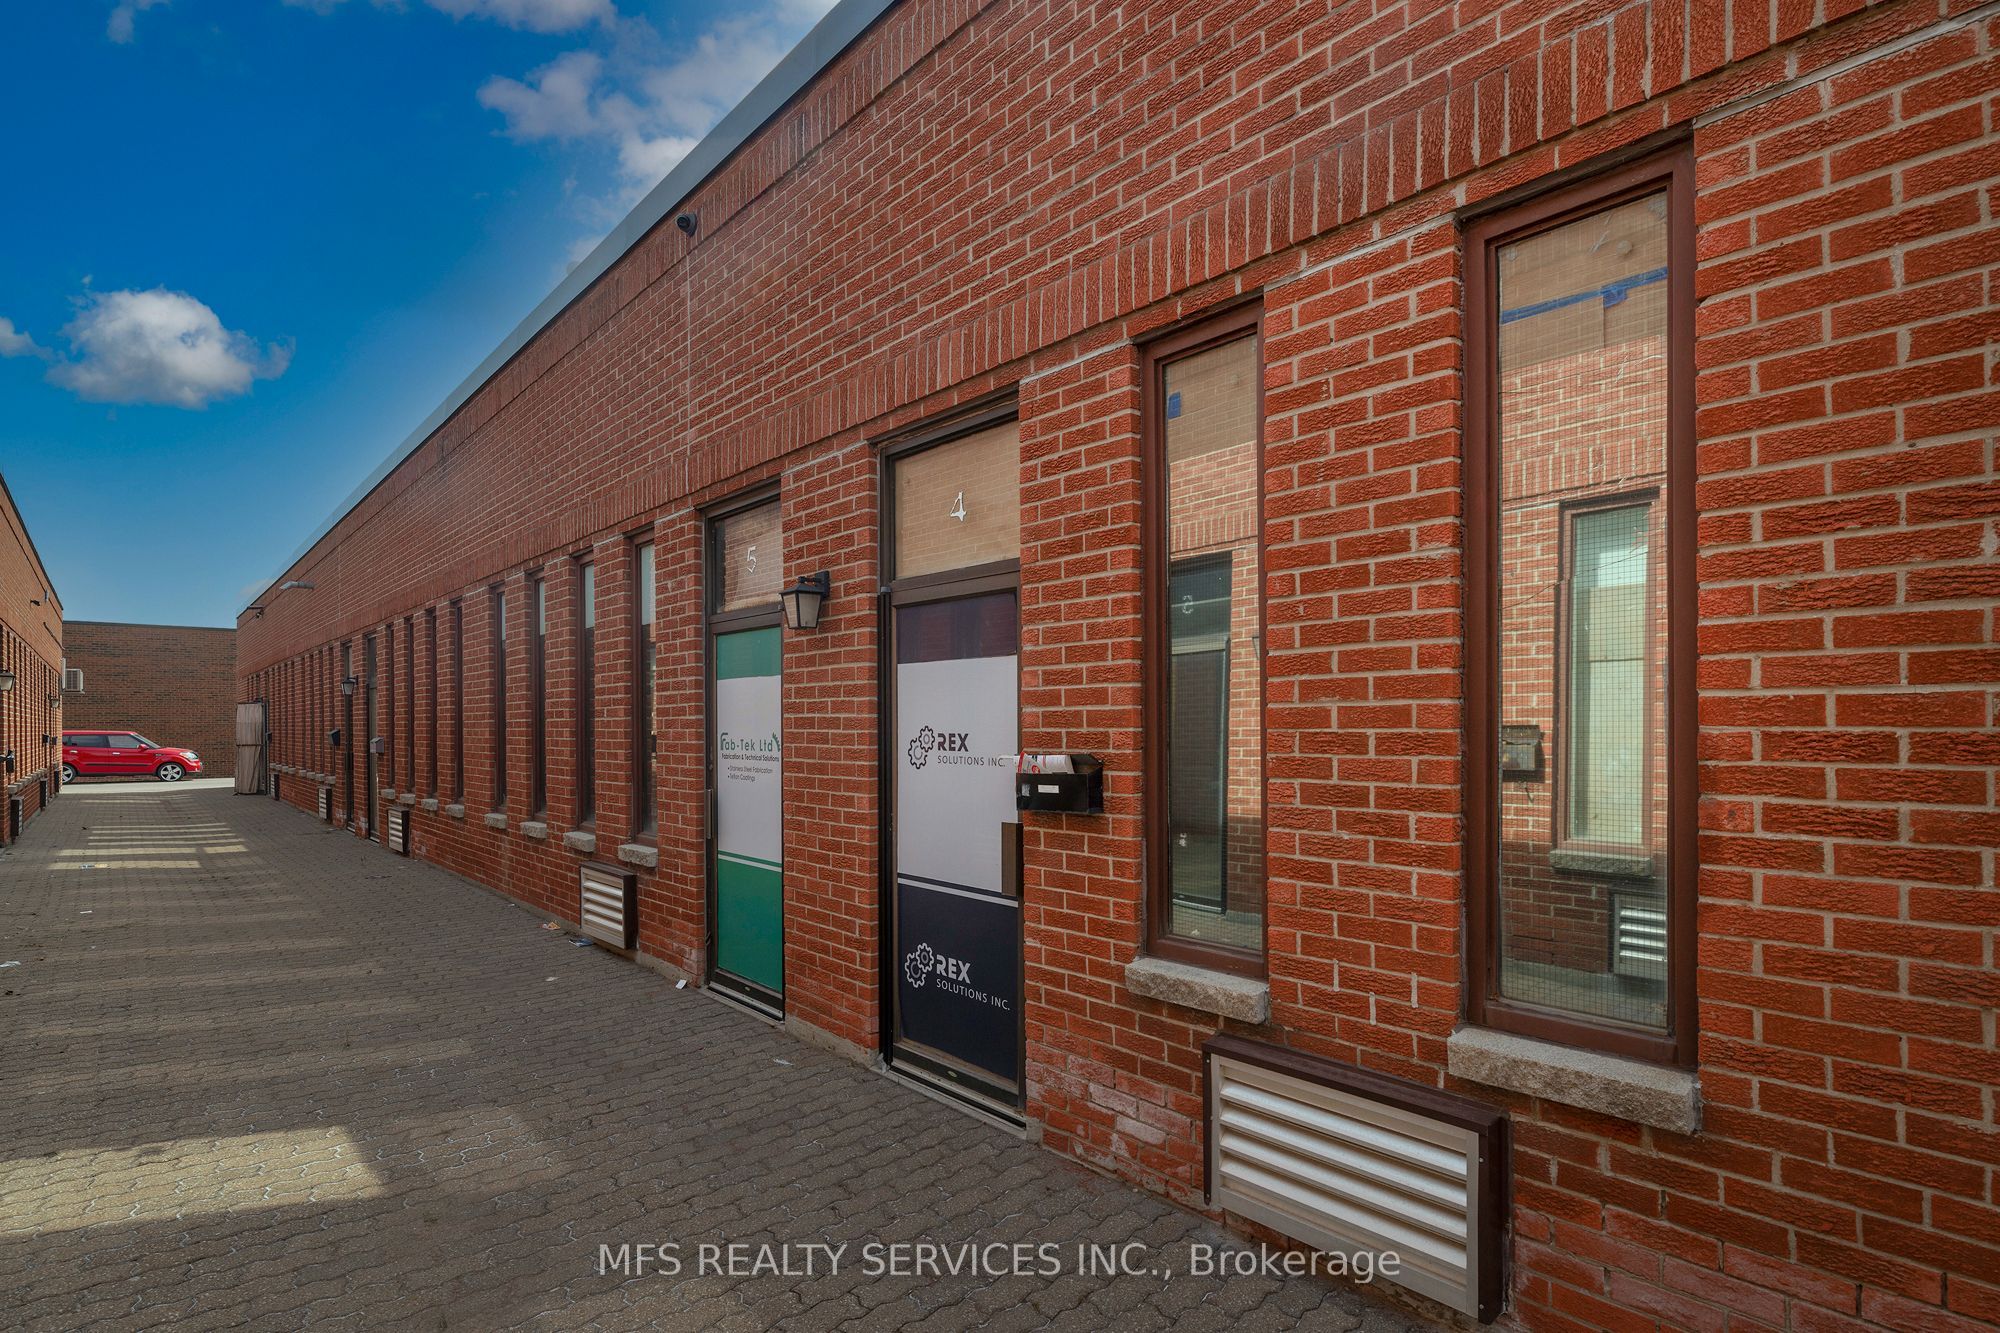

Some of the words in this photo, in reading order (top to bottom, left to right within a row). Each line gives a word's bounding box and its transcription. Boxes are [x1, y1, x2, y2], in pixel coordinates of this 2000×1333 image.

[950, 490, 967, 522] 4
[747, 545, 757, 573] 5
[720, 732, 756, 751] Fab-Tek
[759, 739, 773, 752] Ltd
[937, 732, 969, 752] REX
[721, 752, 741, 760] Fabrication
[745, 753, 762, 761] Technical
[763, 754, 780, 762] Solutions
[937, 755, 985, 766] SOLUTIONS
[936, 953, 971, 985] REX
[936, 978, 988, 1004] SOLUTIONS
[990, 995, 1011, 1011] INC.
